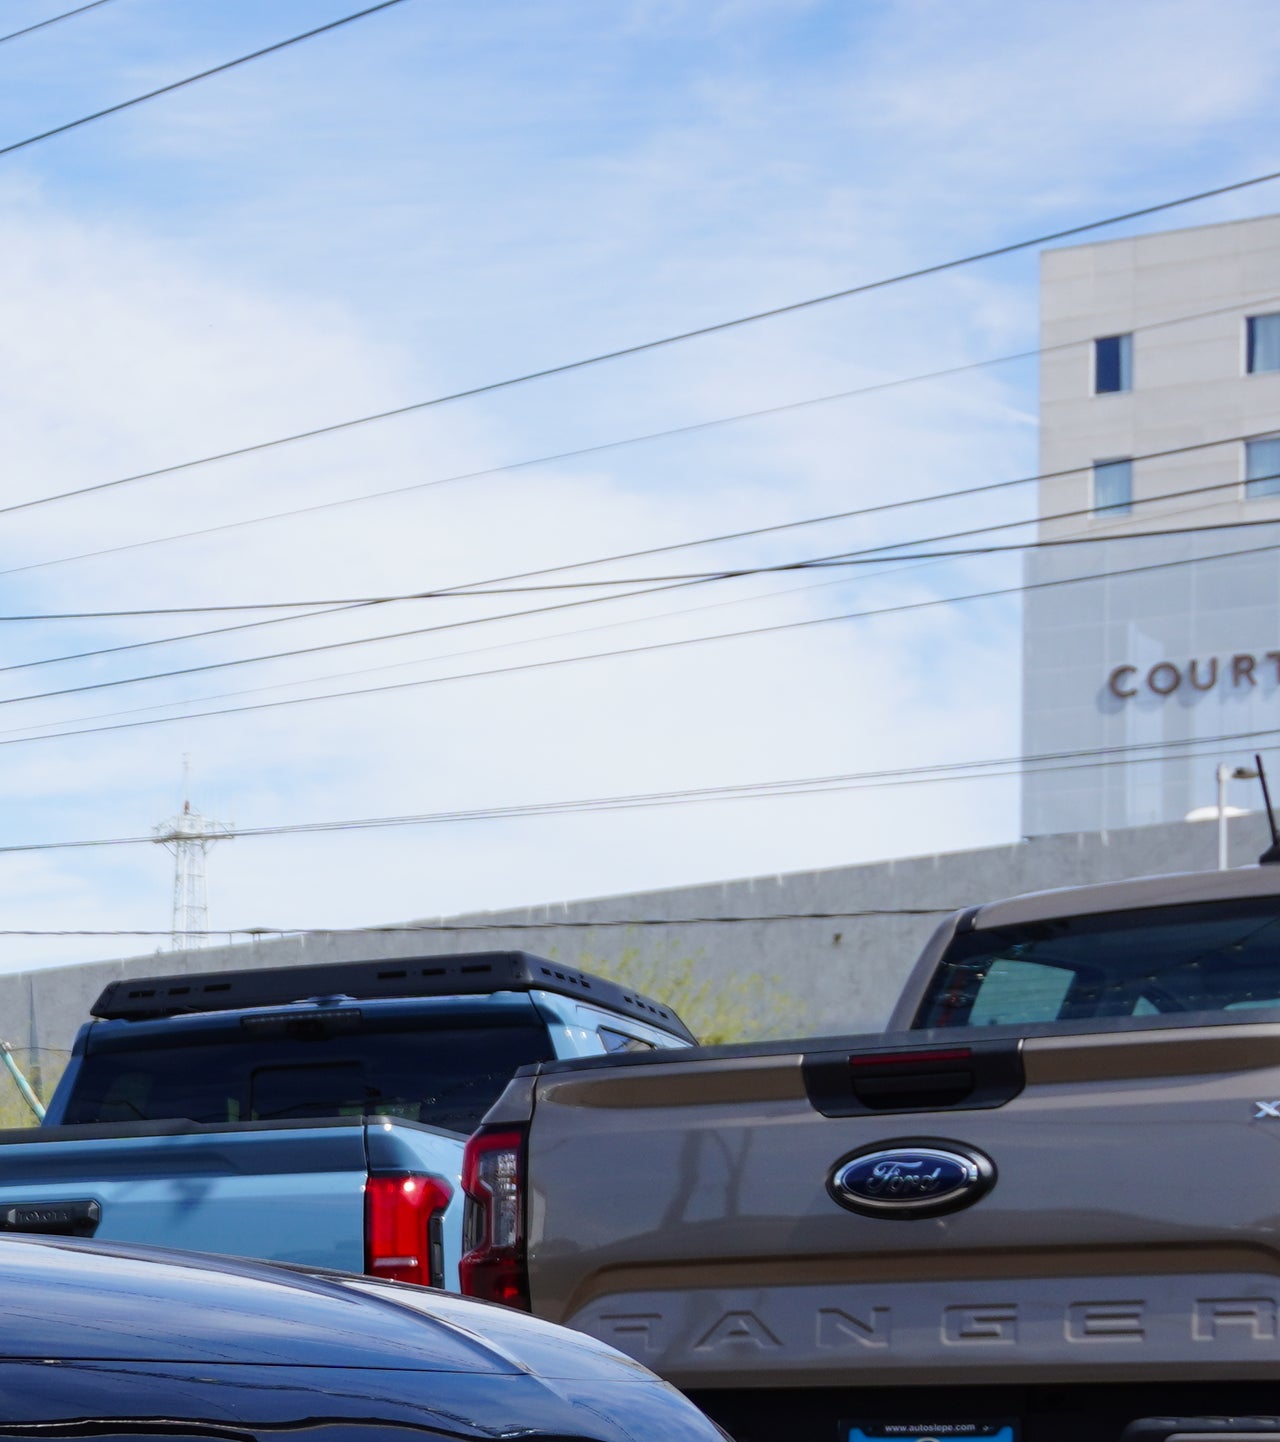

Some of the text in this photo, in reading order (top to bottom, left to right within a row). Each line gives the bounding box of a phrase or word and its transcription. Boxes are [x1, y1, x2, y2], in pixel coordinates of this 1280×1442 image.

[866, 1161, 942, 1193] Ford
[598, 1298, 1278, 1352] RANGER
[885, 1424, 976, 1433] www.autoslepe.com
